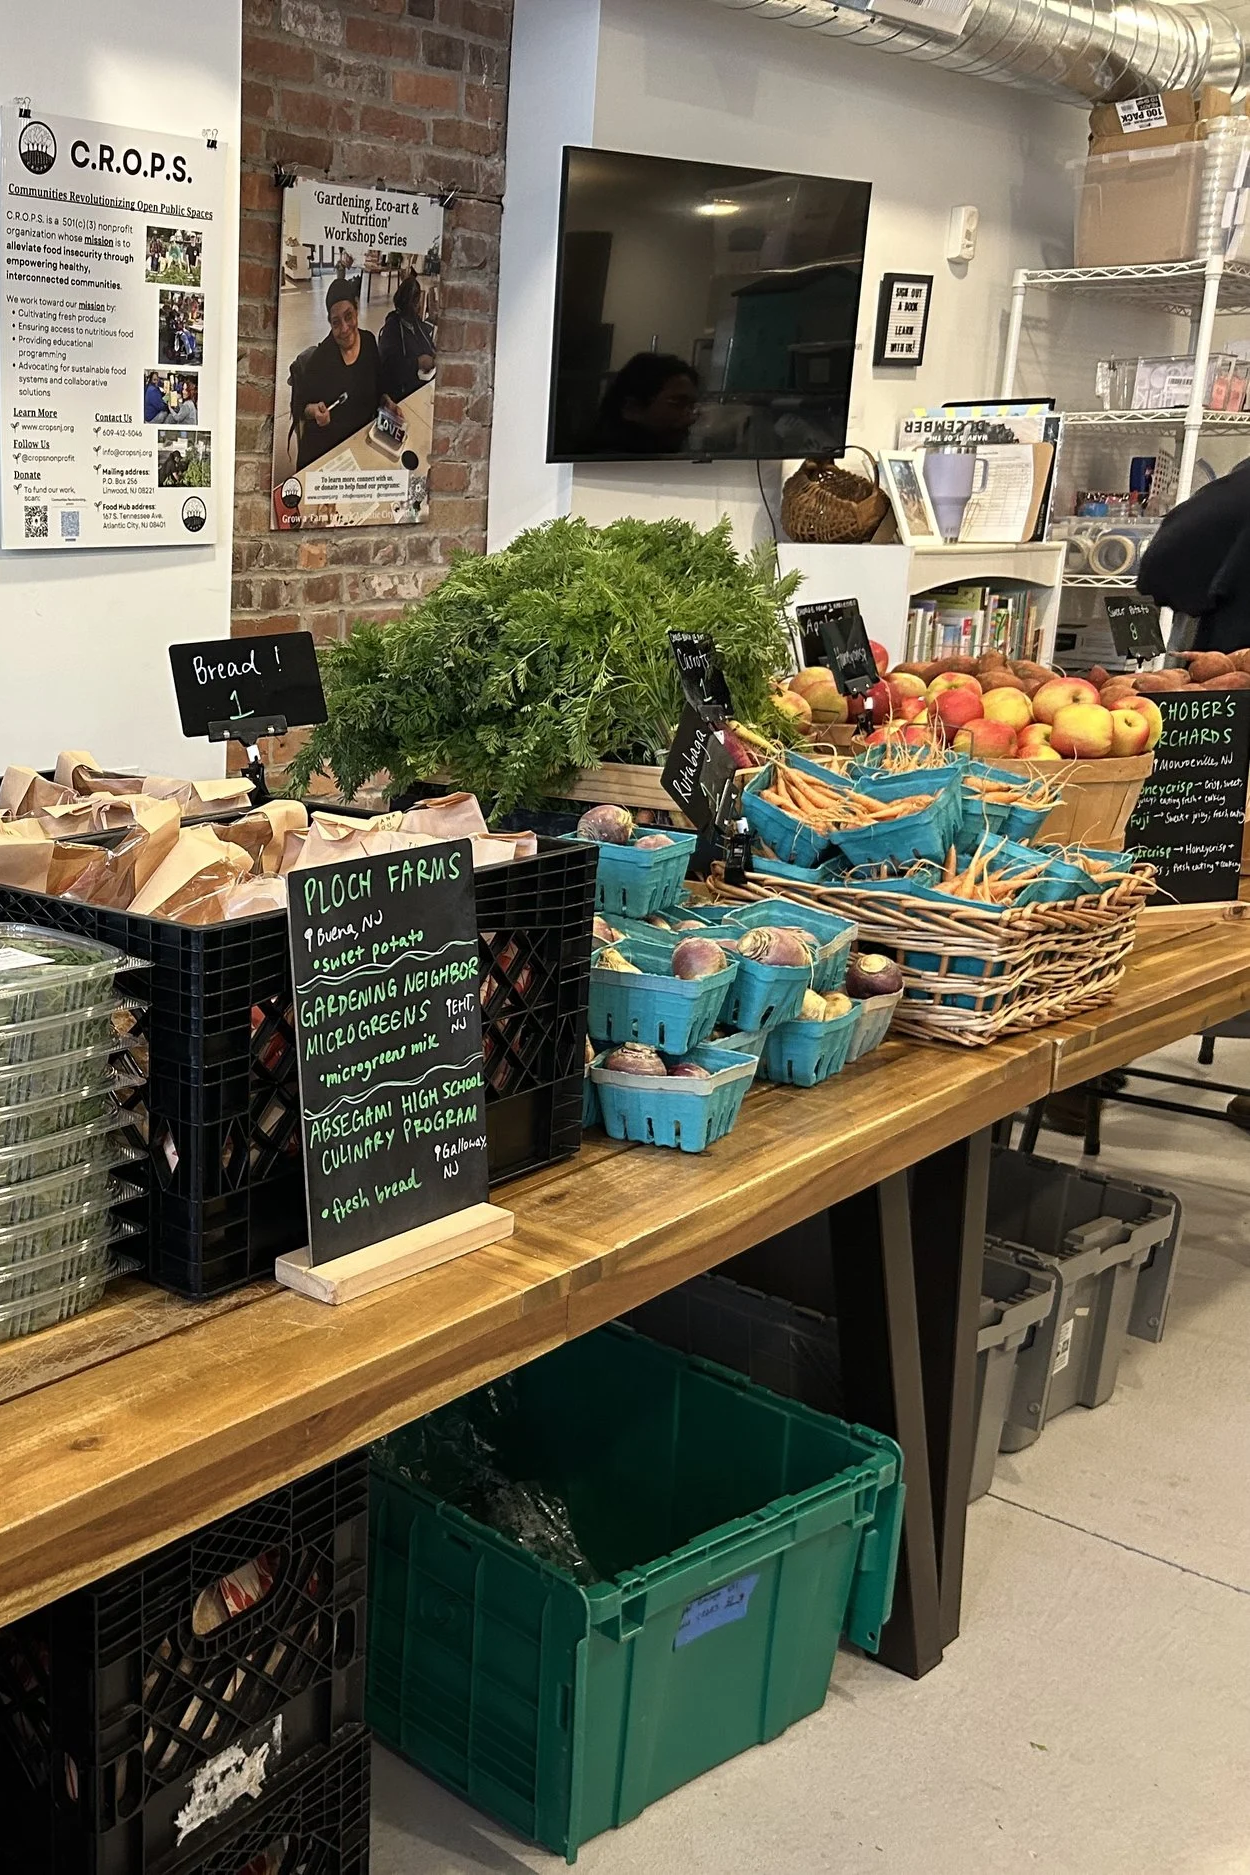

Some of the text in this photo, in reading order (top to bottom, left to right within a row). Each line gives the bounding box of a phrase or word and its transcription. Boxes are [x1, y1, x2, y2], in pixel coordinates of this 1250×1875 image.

[1121, 110, 1145, 123] PACK
[1145, 107, 1163, 118] 100
[70, 140, 193, 184] C.R.O.P.S.
[8, 183, 213, 221] Communities Revolutionizing Open Public Spaces
[375, 198, 409, 215] Eco-art
[411, 202, 419, 216] &
[62, 217, 133, 235] 501(c)(3) nonprofit
[6, 226, 114, 248] organization whose mission
[324, 226, 408, 247] Workshop Series
[6, 242, 134, 263] alleviate food insecurity through
[6, 257, 91, 274] empowering healthy,
[6, 272, 122, 290] interconnected communities.
[911, 288, 923, 298] OUT
[19, 295, 105, 311] work toward mission
[18, 308, 107, 324] Cultivating produce
[18, 322, 117, 338] Ensuring access nutritious
[895, 325, 914, 335] LEARN
[18, 336, 93, 348] Providing educational
[18, 350, 67, 361] programming
[18, 362, 110, 375] Advocating sustainable
[18, 376, 108, 387] systems collaborative
[18, 388, 51, 397] solutions
[13, 407, 58, 418] Learn More
[94, 413, 123, 423] Contact
[13, 439, 39, 449] Follow
[13, 470, 41, 480] Donate
[102, 468, 124, 477] Mailing
[1129, 622, 1138, 641] 8
[192, 649, 262, 685] Bread
[230, 689, 255, 720] 1
[1159, 695, 1237, 723] CHOBER'S
[1158, 728, 1233, 748] RCHARDS
[672, 729, 711, 804] Rutabaga
[1220, 751, 1234, 765] NJ
[1139, 780, 1194, 797] oneycrisp
[1130, 811, 1150, 831] Fuji
[303, 851, 462, 917] PLOCH FARMS
[362, 908, 384, 933] NJ
[322, 928, 424, 973] sweet potato
[300, 956, 479, 1029] GARDENING NEIGHBOR
[305, 999, 432, 1061] MICROGREENS
[325, 1044, 406, 1088] microgreens
[309, 1072, 485, 1149] ABSEGAMI HIGH SCHOOL
[321, 1104, 477, 1176] CULINARY PROGRAM
[443, 1160, 459, 1179] NJ
[332, 1168, 423, 1224] fresh bread
